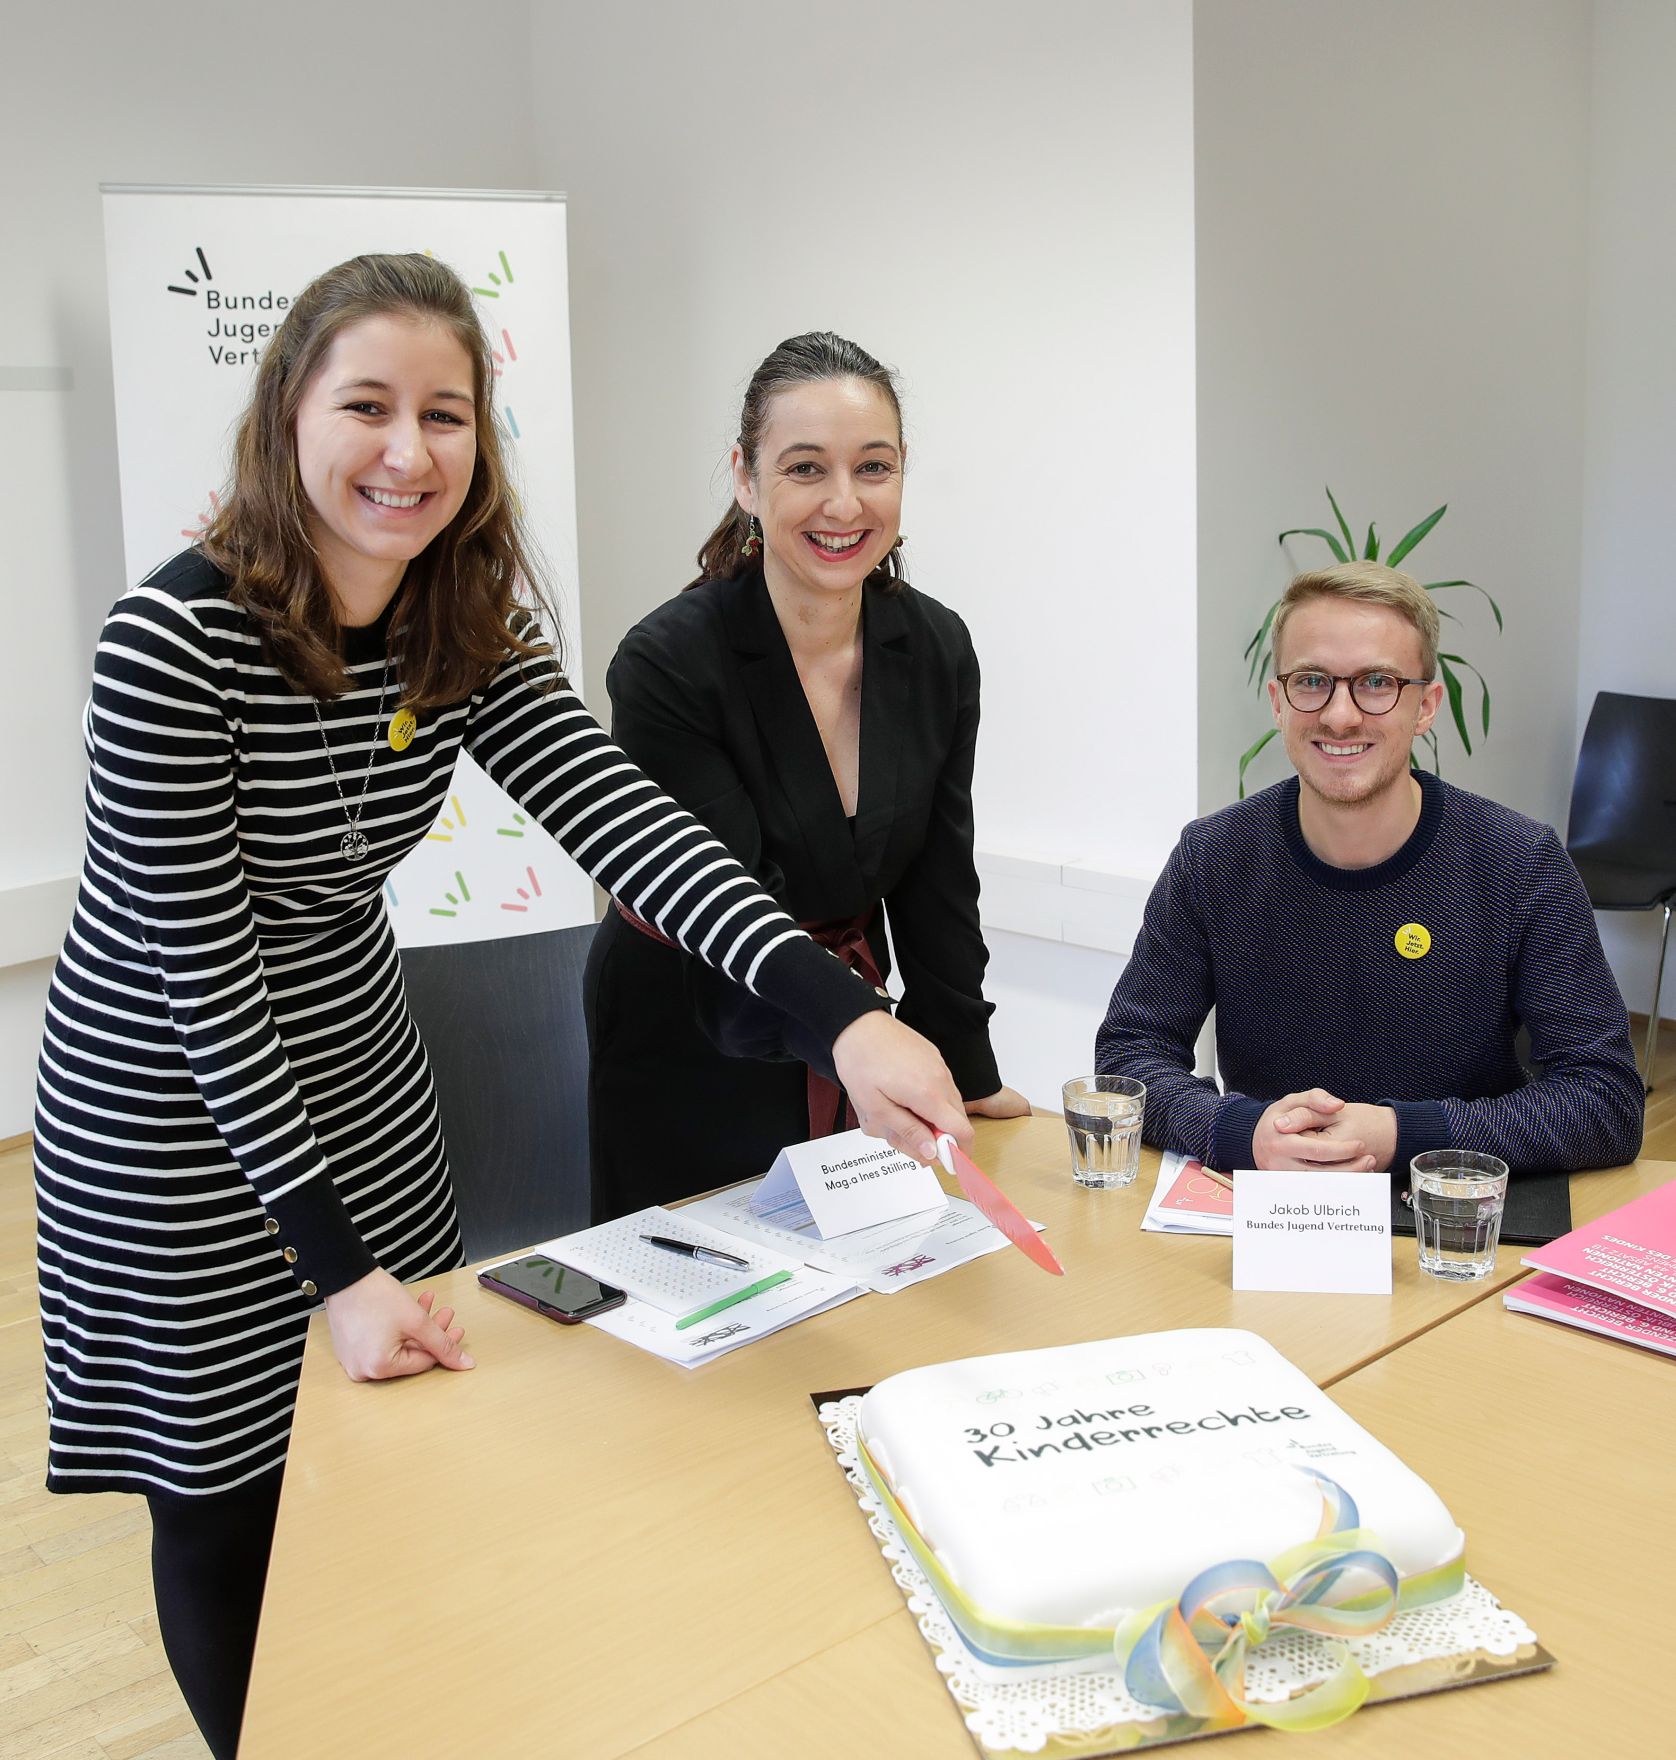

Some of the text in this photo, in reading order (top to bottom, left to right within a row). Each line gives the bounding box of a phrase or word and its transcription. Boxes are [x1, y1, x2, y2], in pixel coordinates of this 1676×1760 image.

[1406, 940, 1424, 949] Jetzt.
[1408, 933, 1421, 942] Wir.
[1404, 946, 1419, 954] Hier.
[825, 1160, 917, 1192] Mag.a Ines Stilling
[1269, 1203, 1360, 1217] Jakob Ulbrich
[1246, 1220, 1384, 1234] Bundes Jugend Vertretung
[1601, 1235, 1646, 1251] KINDES
[1582, 1247, 1643, 1271] NATIONEN
[1647, 1250, 1671, 1260] DES
[1588, 1270, 1641, 1291] BERICHT
[1600, 1267, 1652, 1288] BERICHT
[1563, 1284, 1625, 1306] NATIONEN
[1570, 1306, 1624, 1326] BERICHT
[1582, 1303, 1636, 1323] BERICHT
[962, 1402, 1157, 1445] 30 Jahre
[973, 1403, 1312, 1468] Kinderrechte
